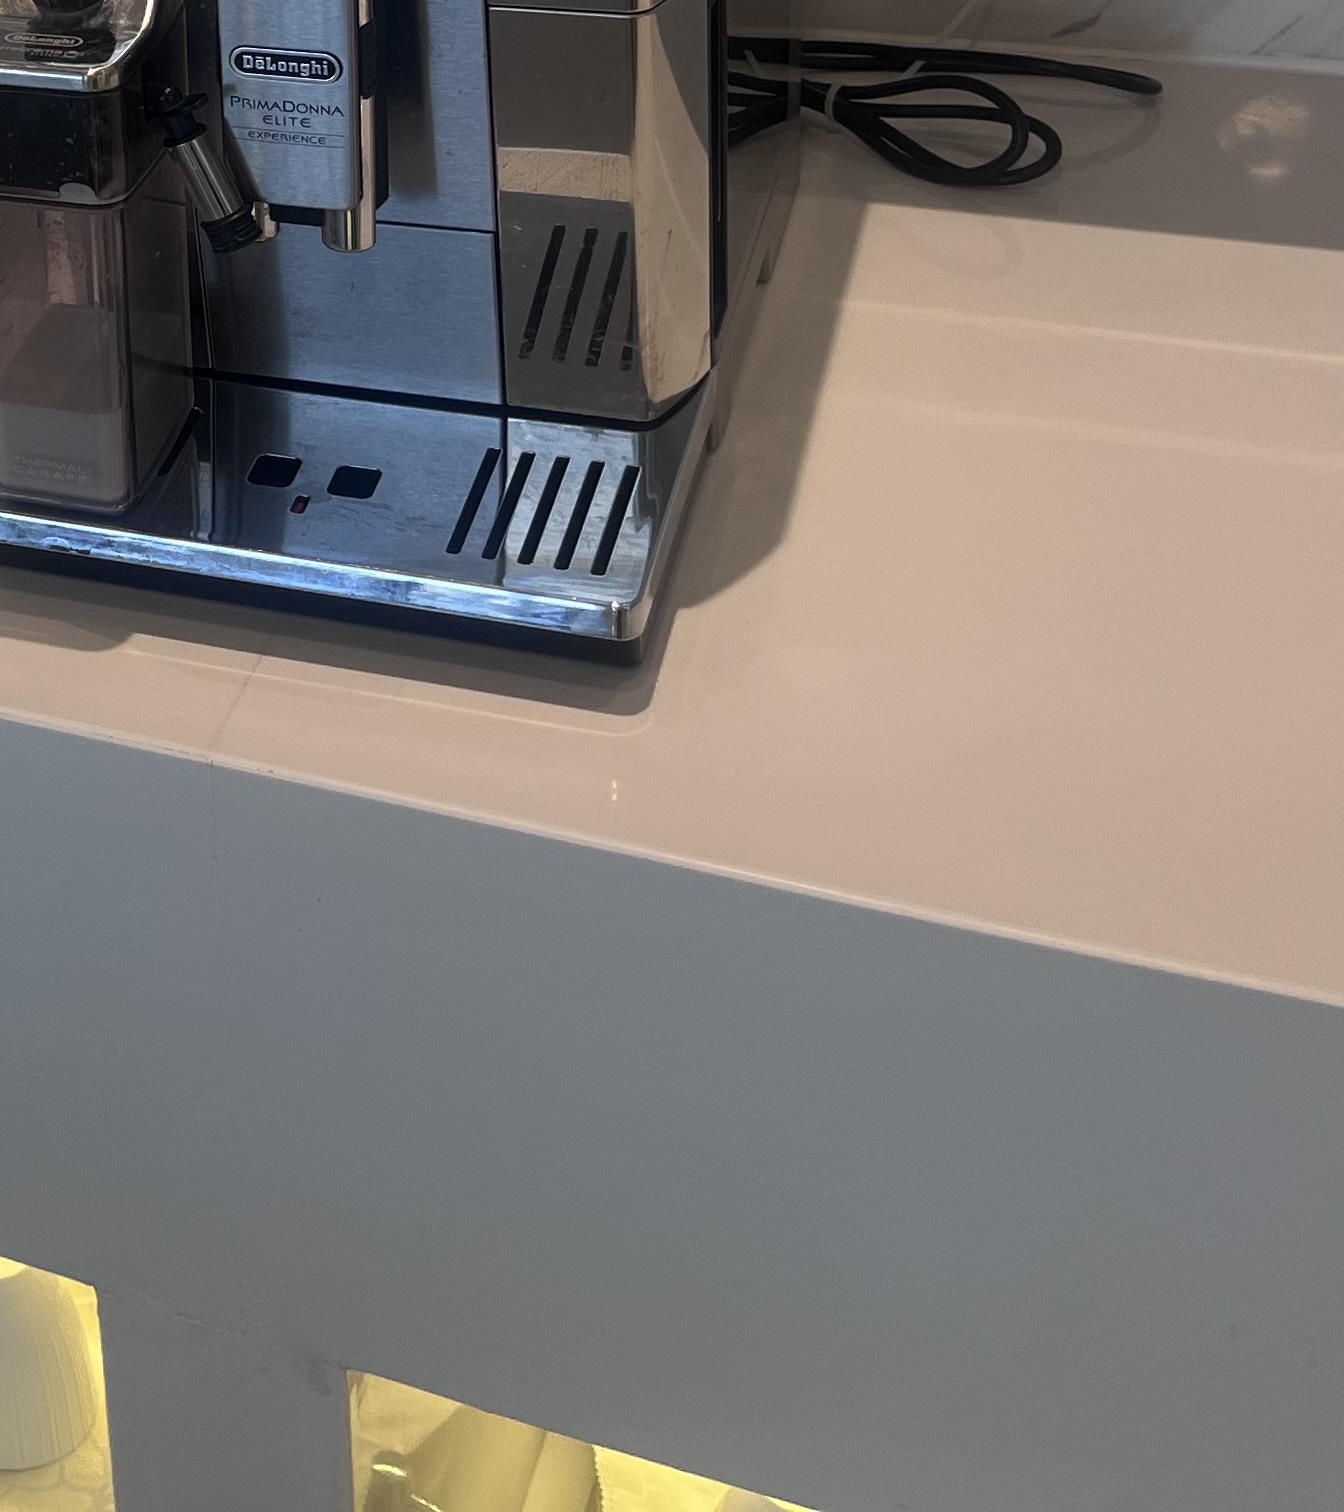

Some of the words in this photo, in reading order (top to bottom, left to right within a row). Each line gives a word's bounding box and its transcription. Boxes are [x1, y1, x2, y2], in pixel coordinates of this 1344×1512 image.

[262, 114, 312, 128] ELITE
[247, 130, 327, 145] EXPERIENCE
[14, 455, 87, 475] THERMAL
